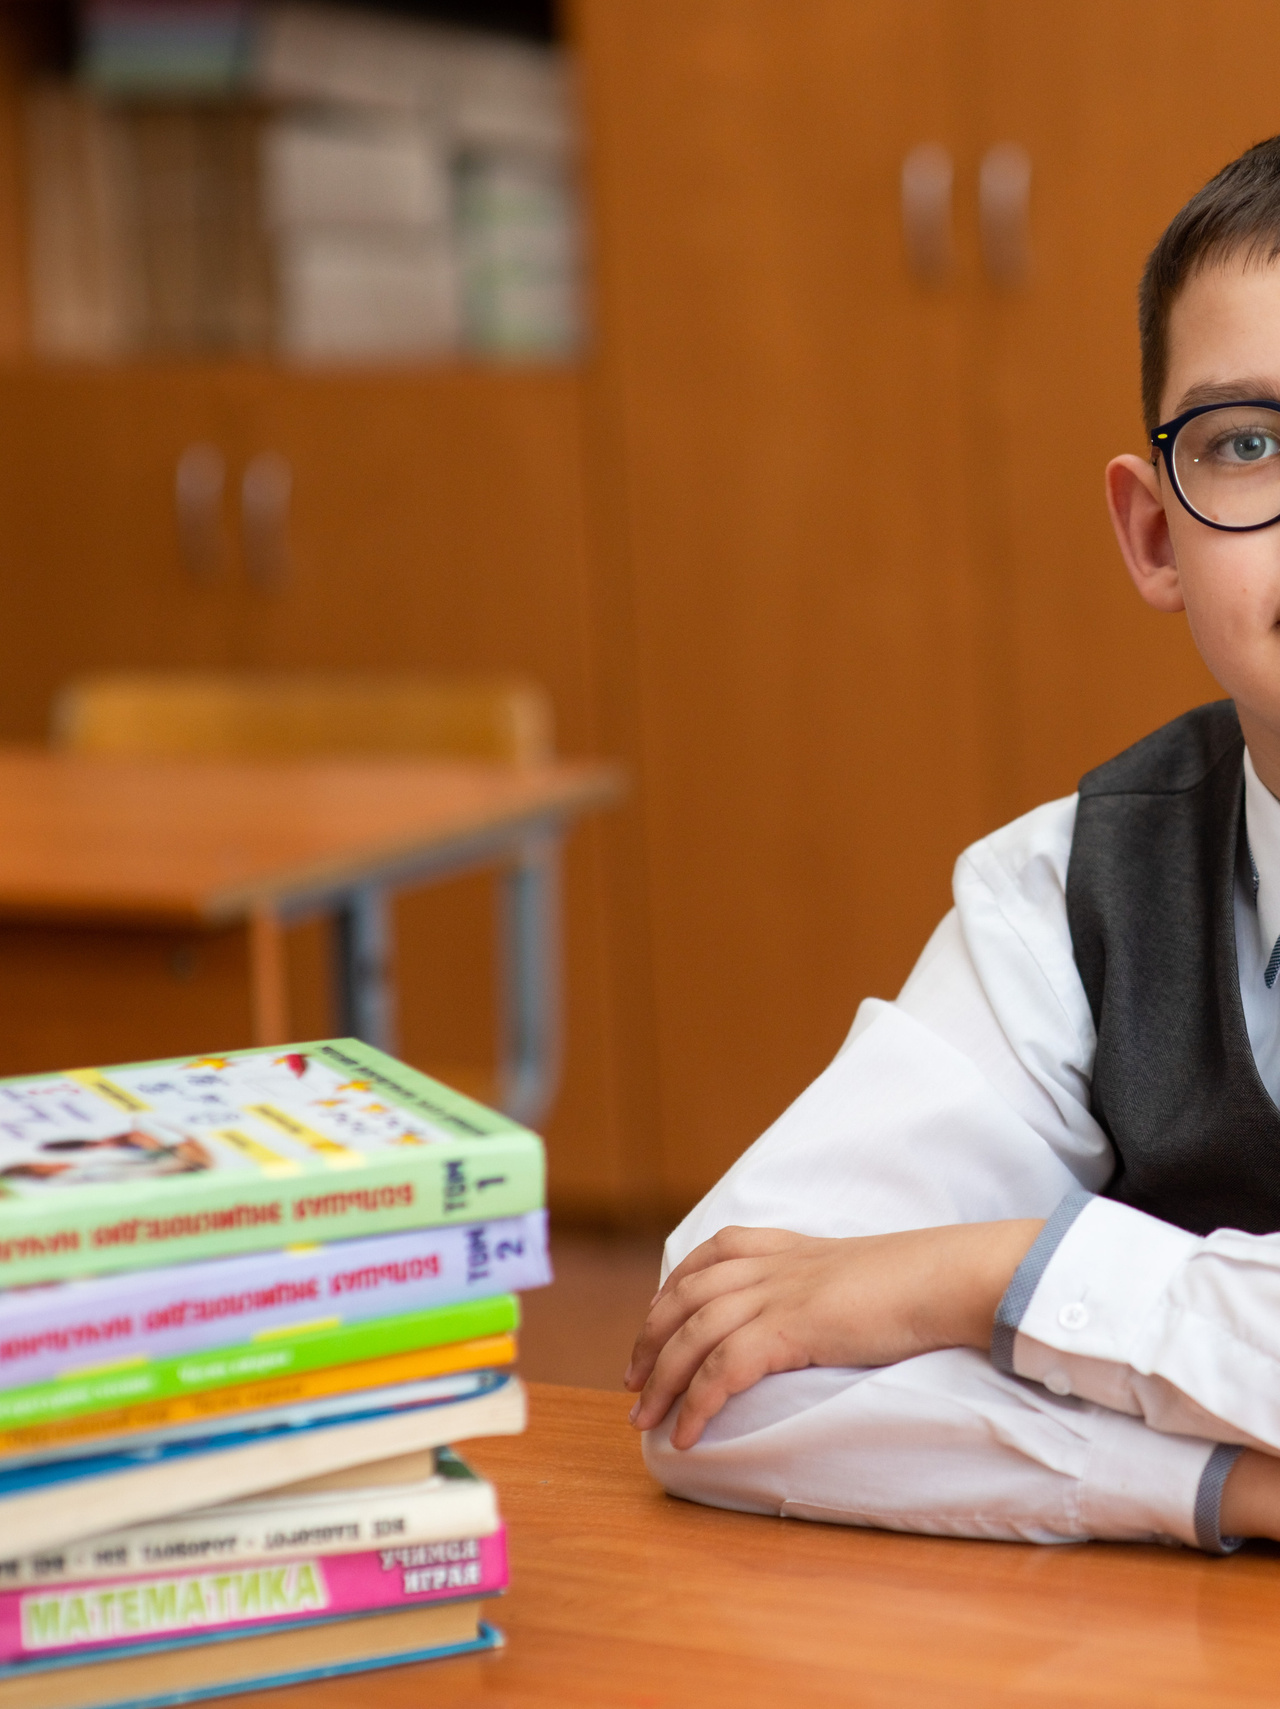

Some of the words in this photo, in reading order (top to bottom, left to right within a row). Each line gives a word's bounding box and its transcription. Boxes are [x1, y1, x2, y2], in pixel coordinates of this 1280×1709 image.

[292, 1183, 414, 1221] БОЛЬШАЯ
[443, 1159, 468, 1214] ТОМ
[474, 1175, 506, 1192] 1
[466, 1225, 490, 1285] ТОМ
[494, 1239, 525, 1260] 2
[328, 1253, 441, 1297] БОЛЬШАЯ
[379, 1539, 479, 1571] УЧИМСЯ
[402, 1562, 480, 1595] ИГРАЯ
[24, 1560, 324, 1648] МАТЕМАТИКА
